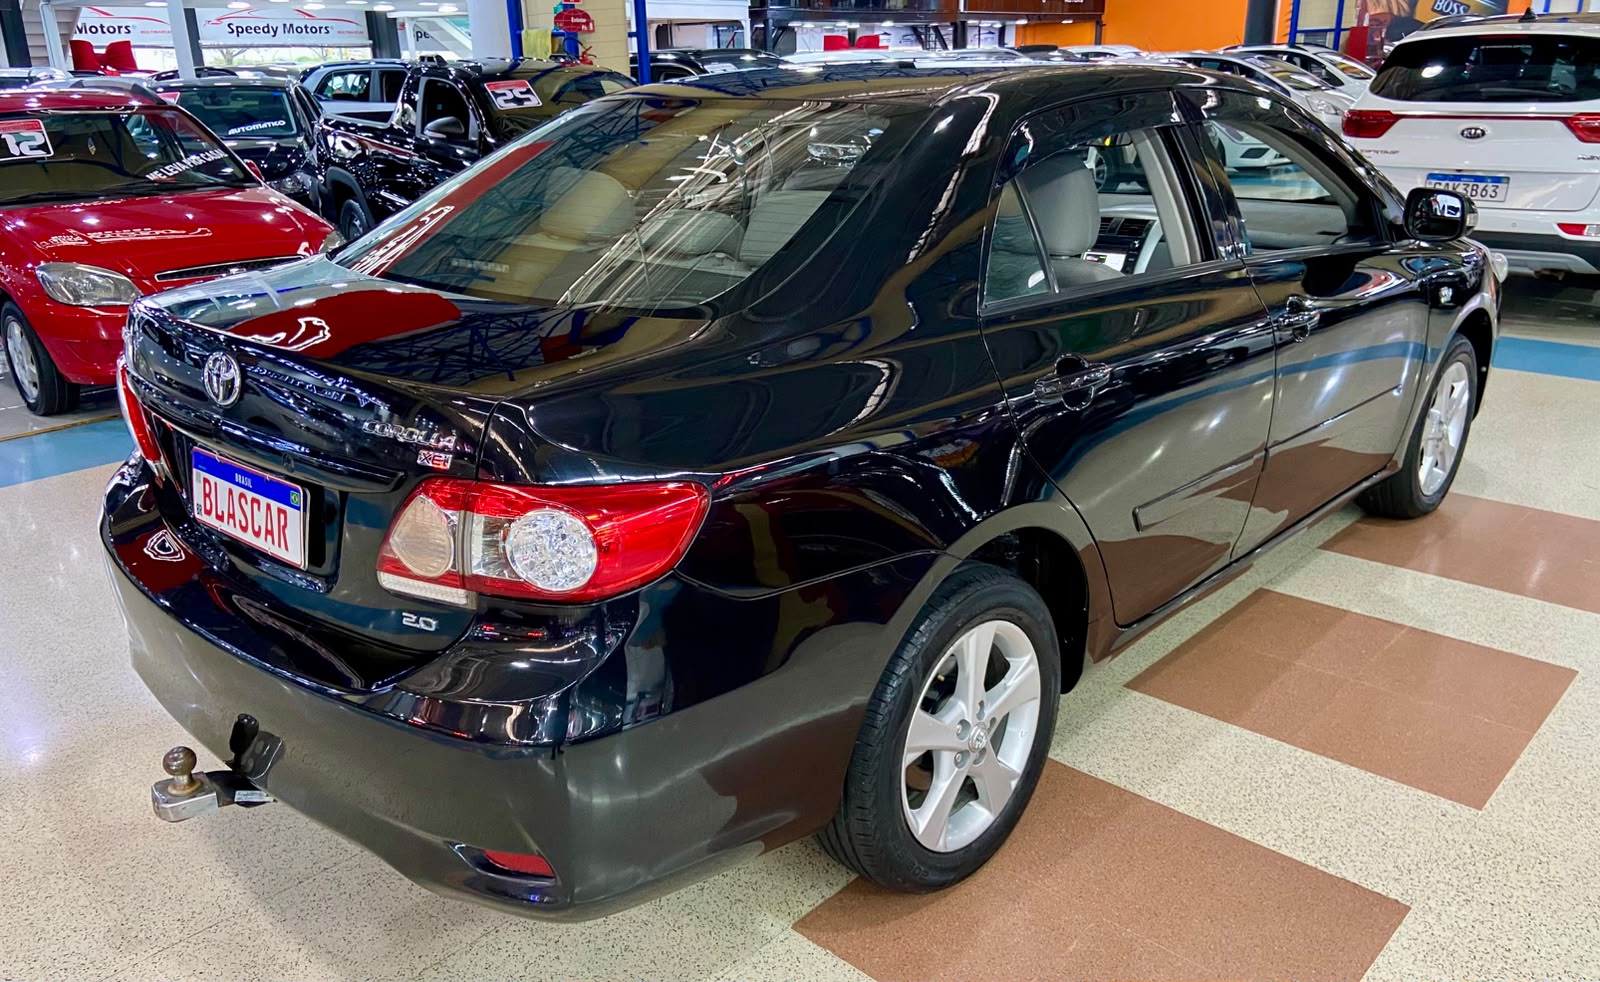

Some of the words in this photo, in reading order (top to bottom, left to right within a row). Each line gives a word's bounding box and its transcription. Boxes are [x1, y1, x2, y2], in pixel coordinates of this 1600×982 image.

[74, 23, 131, 34] Motors
[227, 23, 278, 37] Speedy
[283, 23, 330, 34] Motors
[495, 88, 538, 107] 25
[1, 132, 47, 156] 12
[145, 170, 167, 181] ME
[160, 161, 188, 177] LEVA
[362, 421, 457, 451] COROLLA
[234, 473, 253, 488] BRASIL
[202, 476, 289, 552] BLASCAR
